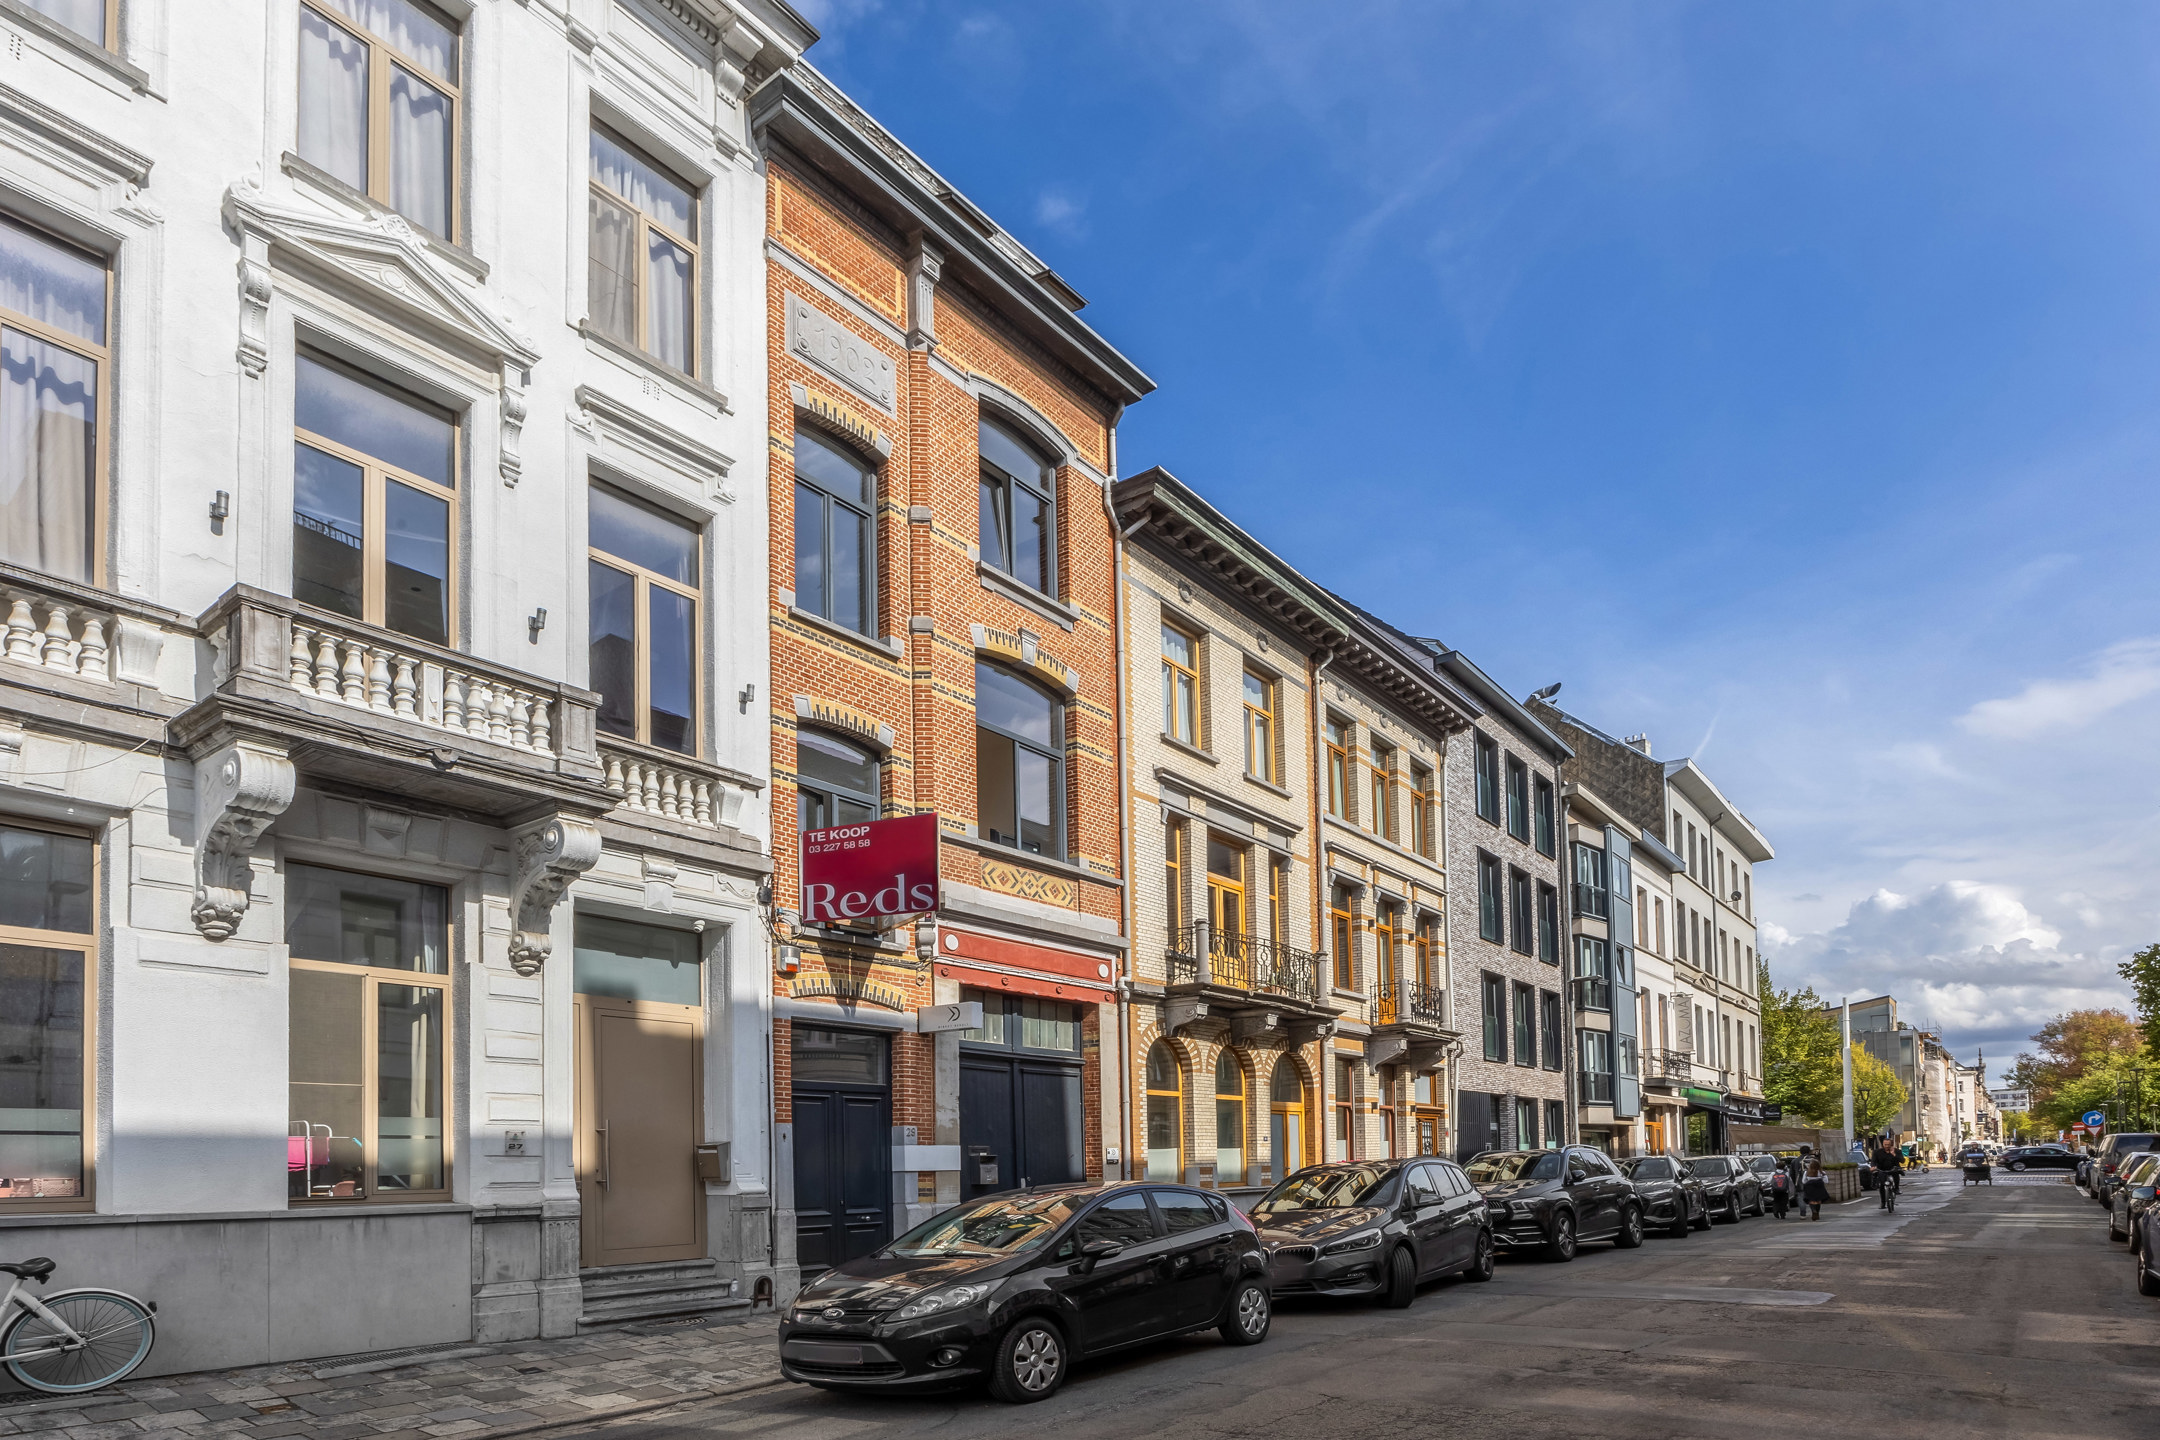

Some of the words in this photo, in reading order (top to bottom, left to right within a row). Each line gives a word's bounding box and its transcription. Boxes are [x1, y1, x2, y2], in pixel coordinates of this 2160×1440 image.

[814, 327, 877, 386] 1902
[808, 831, 827, 843] TE
[829, 825, 870, 840] KOOP
[808, 845, 821, 853] 03
[823, 842, 841, 852] 227
[843, 840, 855, 849] 58
[858, 838, 870, 848] 58
[803, 873, 934, 921] Reds
